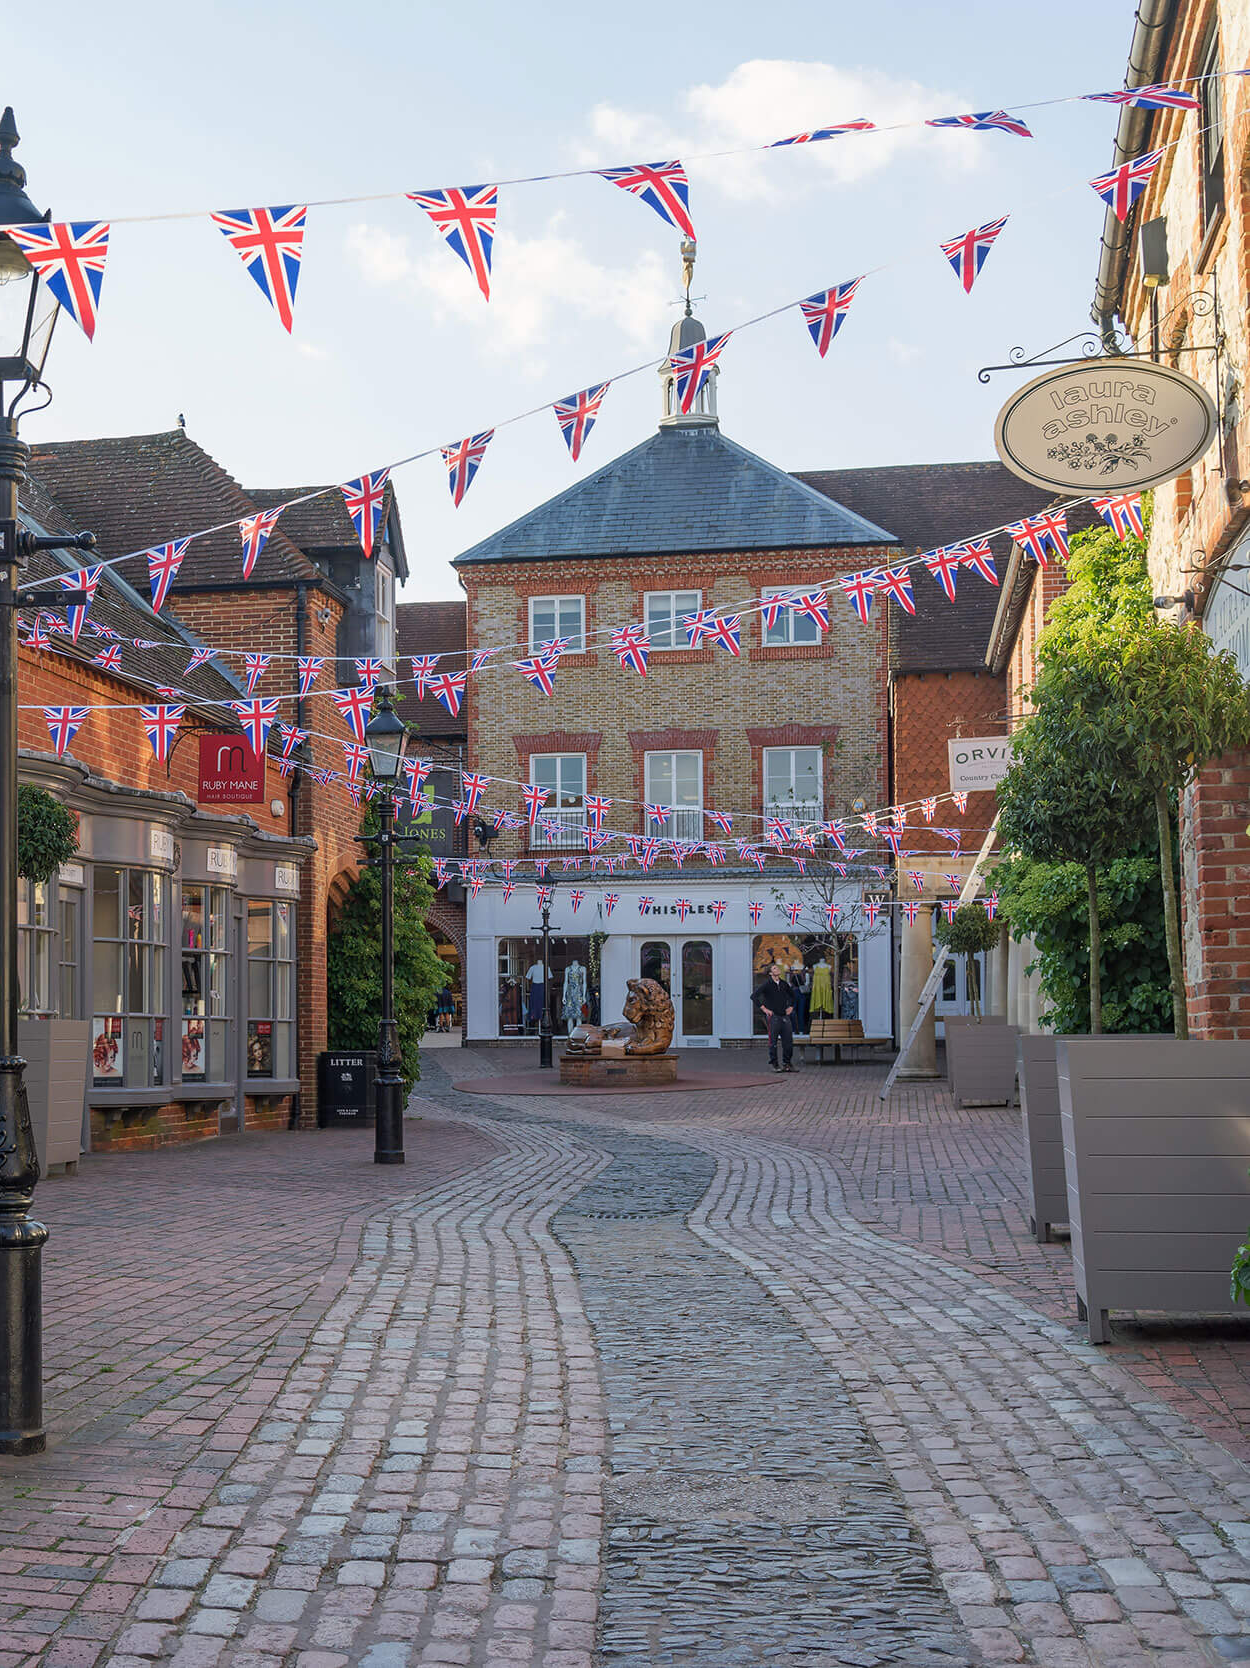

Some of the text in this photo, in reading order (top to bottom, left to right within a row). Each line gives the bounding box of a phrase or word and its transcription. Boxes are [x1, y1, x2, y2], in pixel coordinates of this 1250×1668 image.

[1049, 380, 1157, 411] laura
[202, 780, 258, 790] RUBY MANE
[638, 904, 714, 915] HISLES
[330, 1058, 364, 1067] LITTER
